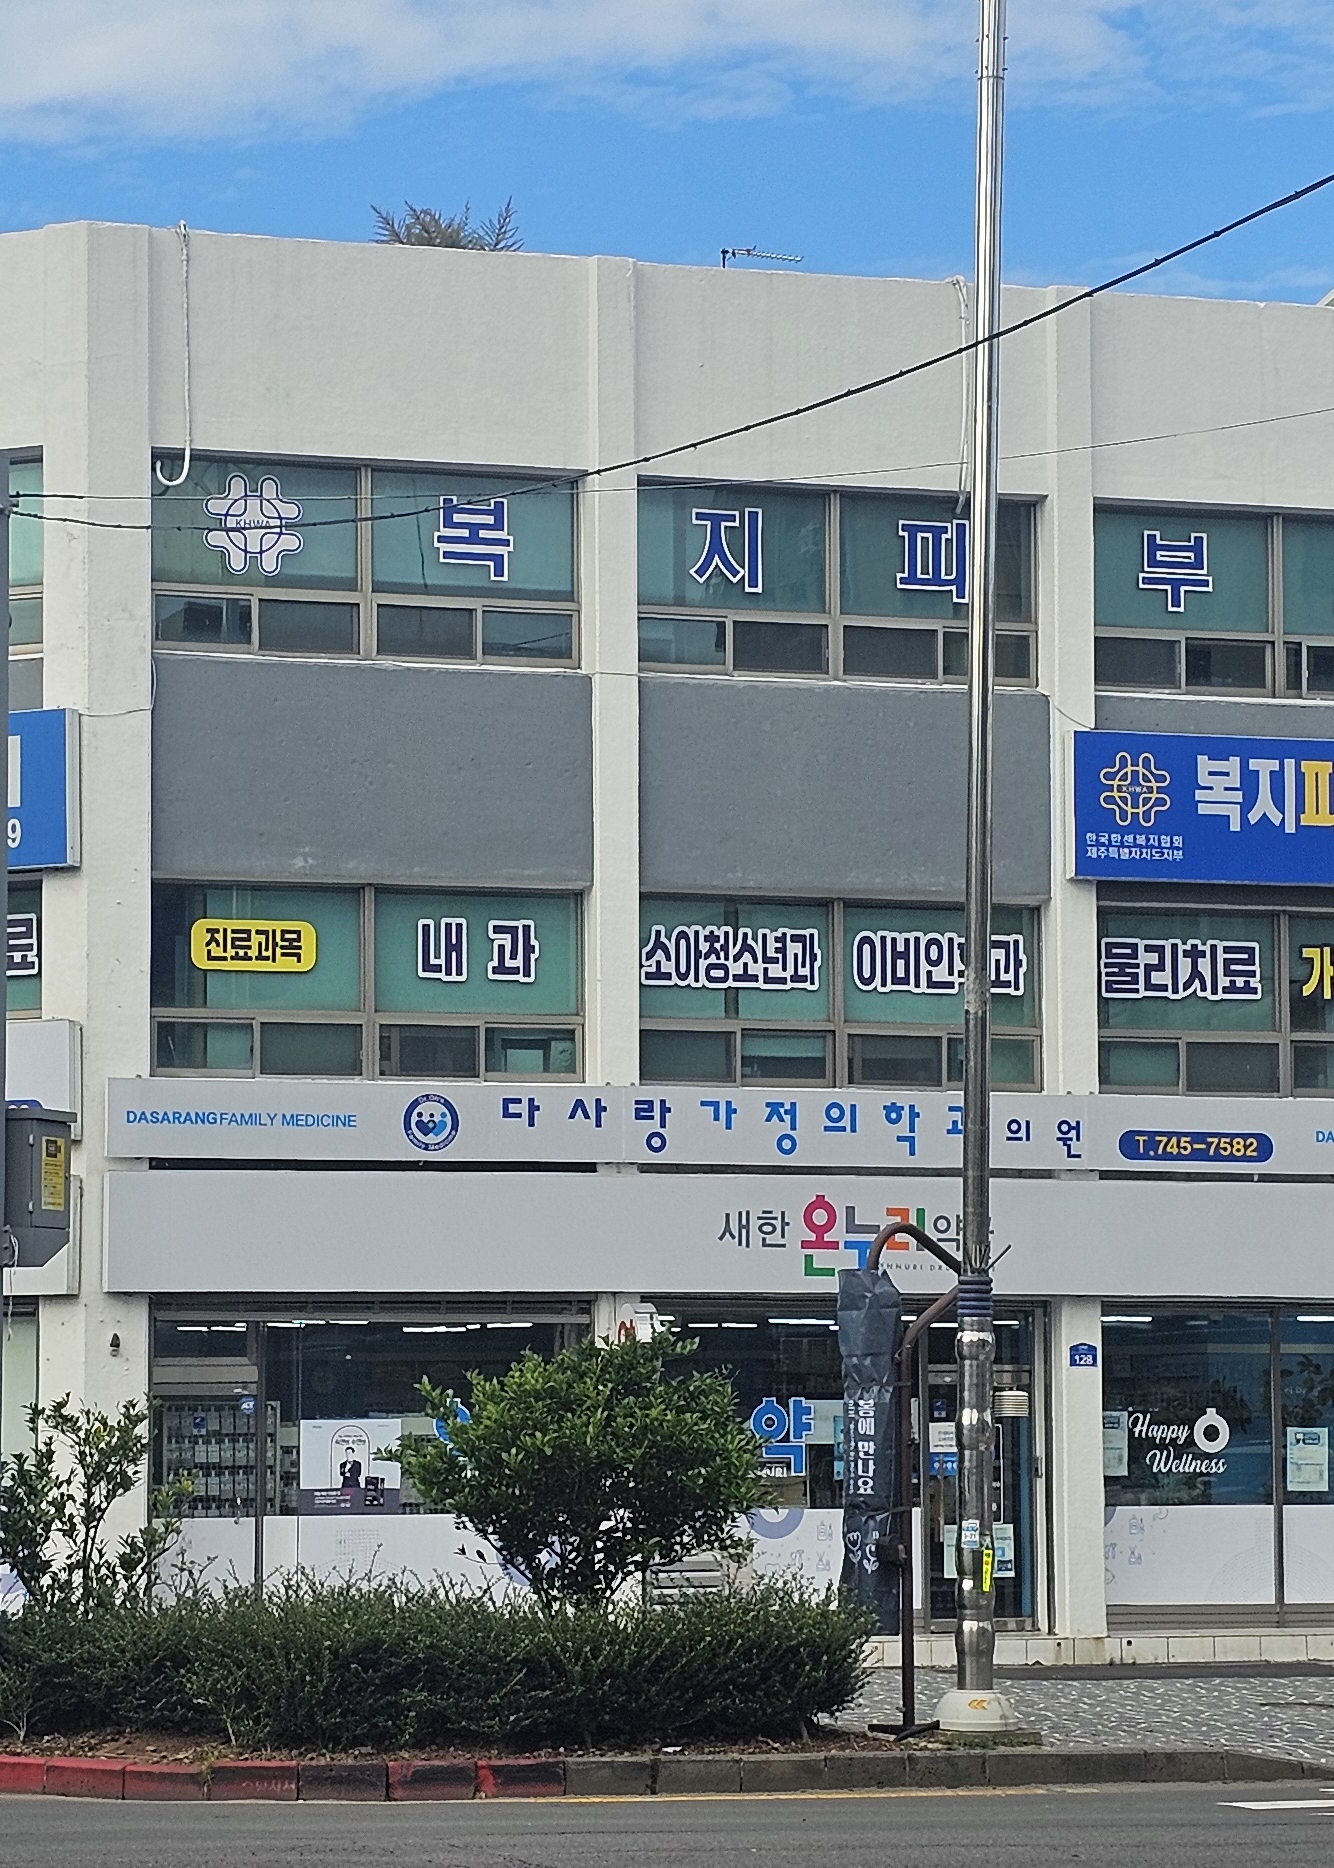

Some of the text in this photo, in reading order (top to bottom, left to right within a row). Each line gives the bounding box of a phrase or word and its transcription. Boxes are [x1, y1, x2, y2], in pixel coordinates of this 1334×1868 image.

[1086, 833, 1183, 848] 한국한센복지협회
[1086, 846, 1184, 861] 제주특별자치도지부
[205, 928, 303, 964] 진료과목
[642, 925, 822, 990] 소아청소년과
[853, 930, 1027, 995] 이비인과
[1101, 937, 1262, 1000] 물리치료
[126, 1110, 357, 1128] DASARANG FAMILY MEDICINE
[1134, 1135, 1258, 1157] T.745-7582
[879, 1262, 925, 1271] NNURI
[1074, 1354, 1094, 1365] 128
[750, 1397, 814, 1476] 약
[1128, 1412, 1190, 1445] Happy
[1146, 1448, 1227, 1475] Wellness
